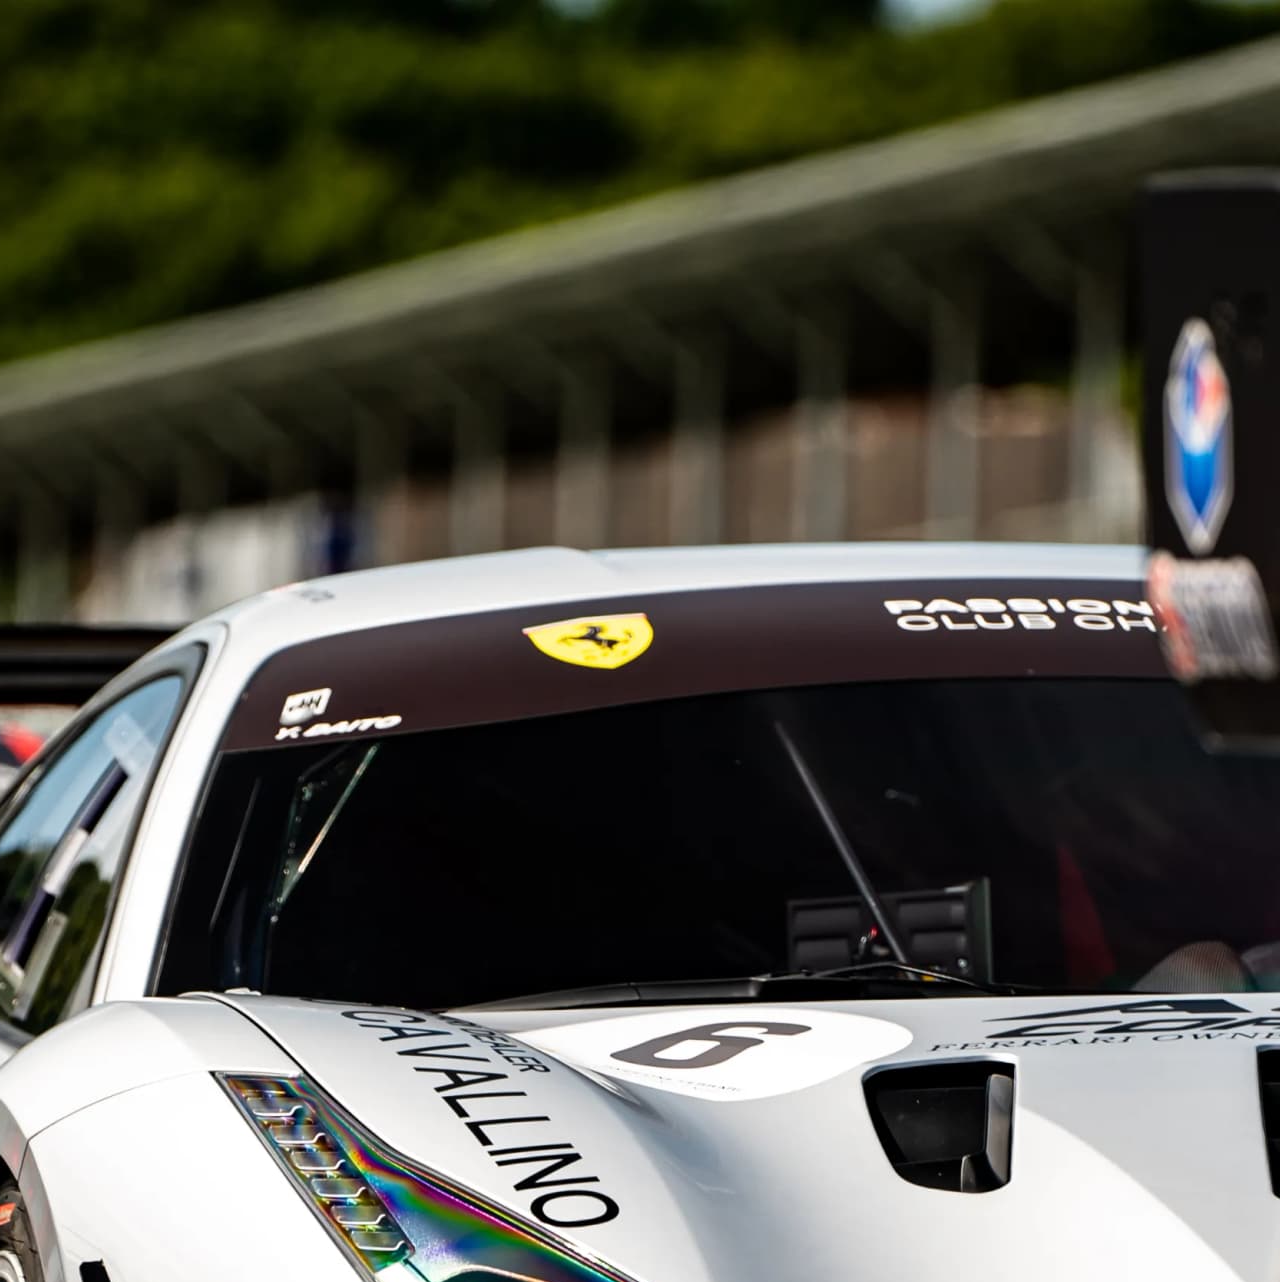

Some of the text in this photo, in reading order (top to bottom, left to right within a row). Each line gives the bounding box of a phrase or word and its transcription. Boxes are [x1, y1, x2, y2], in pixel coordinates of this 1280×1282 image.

[896, 614, 1057, 631] CLUB
[460, 1023, 551, 1073] DEALER
[609, 1021, 813, 1069] 6
[930, 1037, 1132, 1052] FERRARI
[340, 1010, 620, 1228] CAVALLINO
